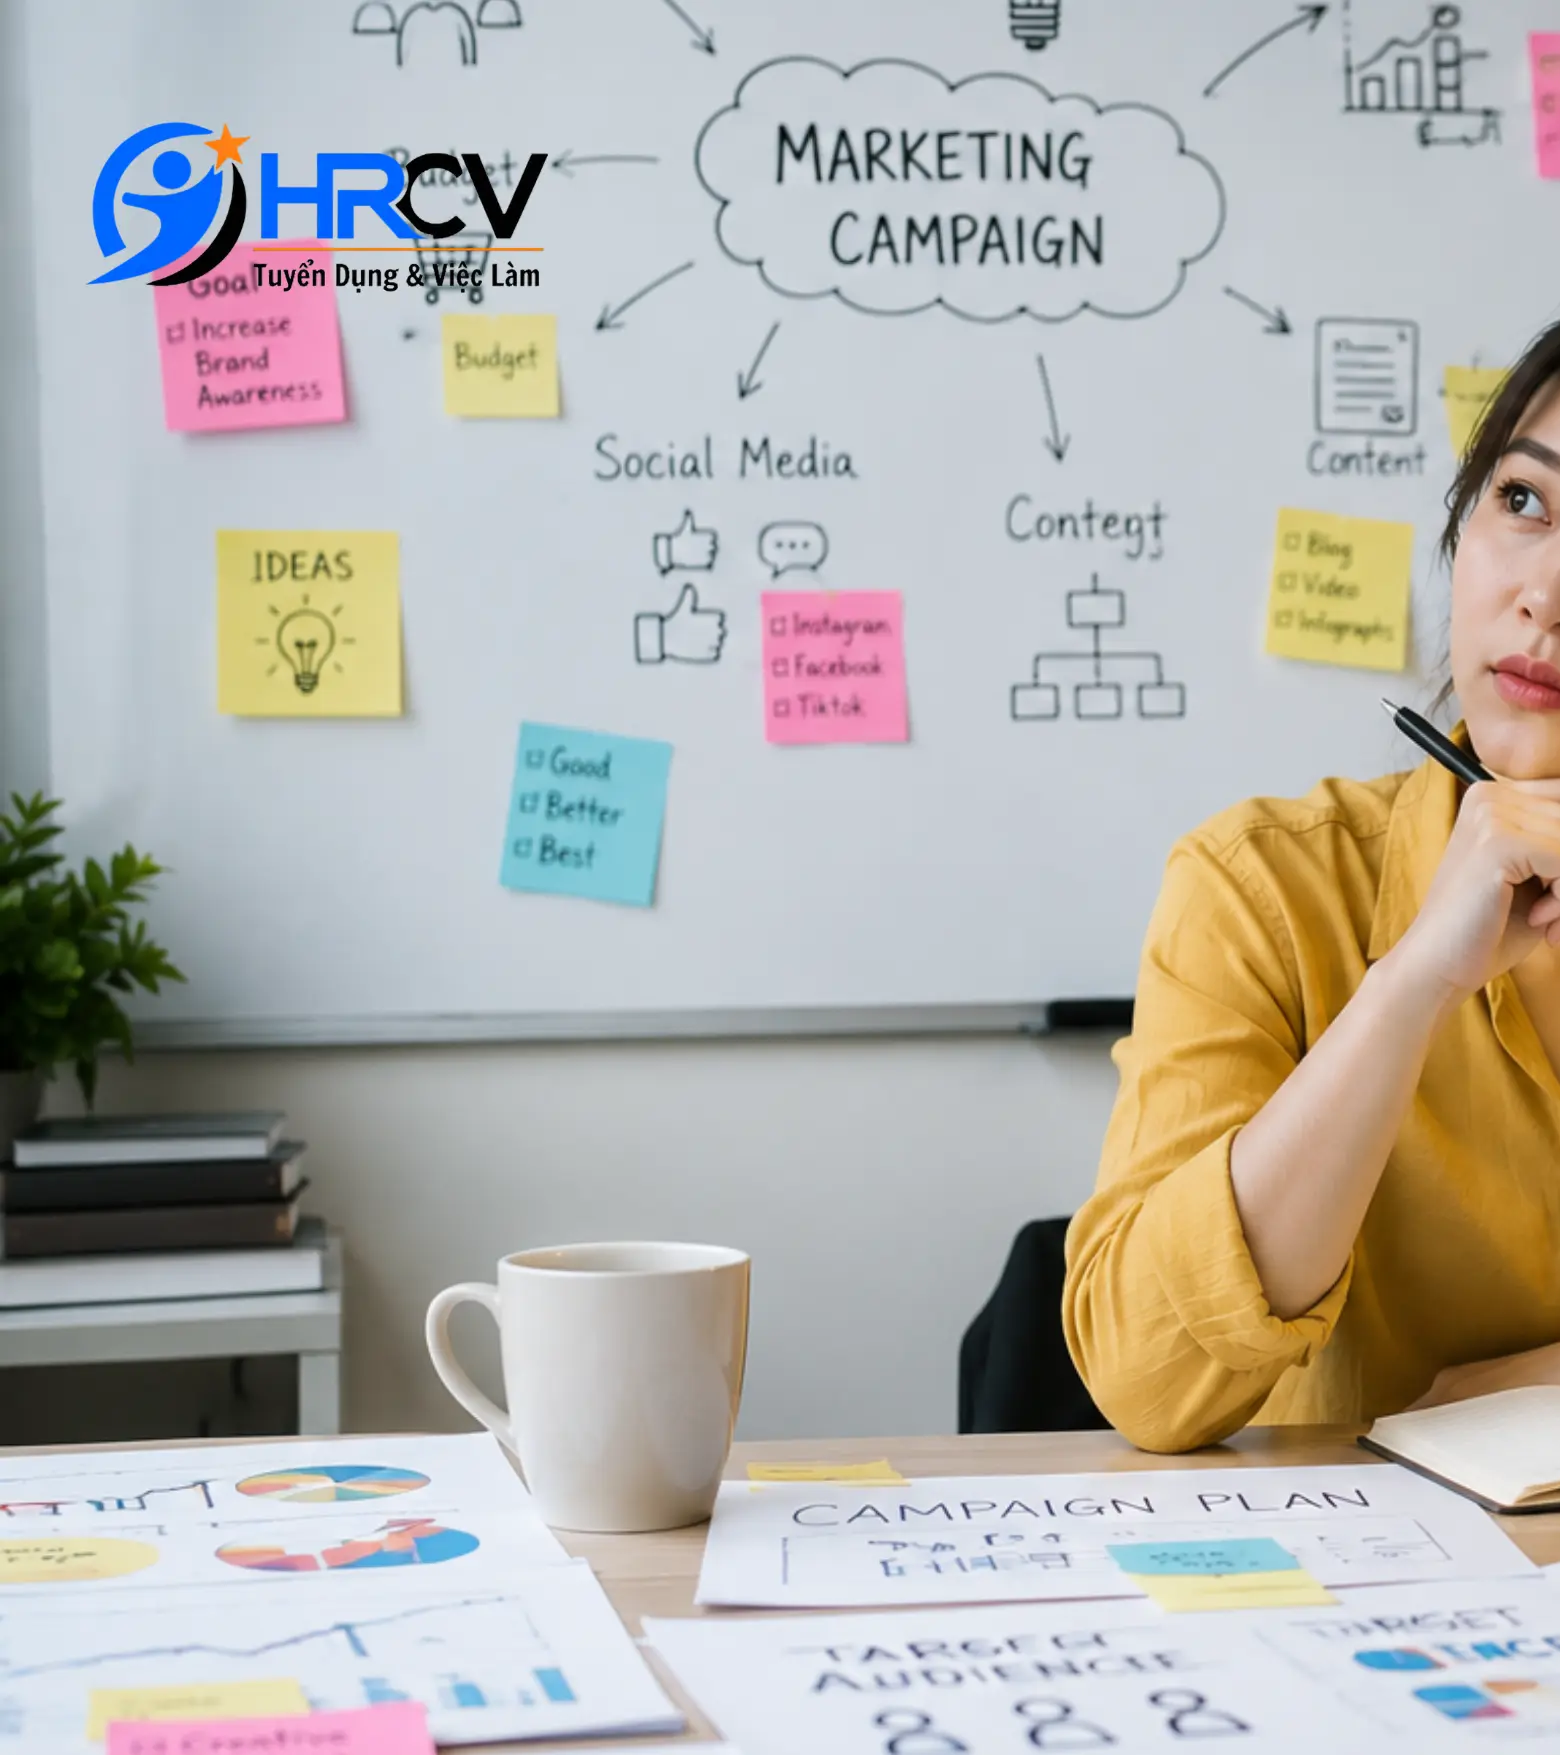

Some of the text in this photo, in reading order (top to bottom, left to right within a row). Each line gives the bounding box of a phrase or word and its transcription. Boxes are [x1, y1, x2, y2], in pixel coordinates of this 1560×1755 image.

[776, 123, 1093, 190] MARKETING
[830, 211, 1104, 268] CAMPAIGN
[192, 317, 291, 342] Increase
[195, 347, 270, 377] Brand
[453, 340, 538, 381] Budget
[198, 379, 323, 410] Awareness
[594, 432, 859, 481] Social Media
[1307, 440, 1427, 478] Content
[252, 549, 355, 583] IDEAS
[1302, 572, 1361, 600] Video
[793, 613, 892, 647] Instagram
[794, 653, 884, 678] Facebook
[549, 744, 613, 781] Good
[545, 788, 625, 828] Better
[538, 832, 597, 871] Best
[791, 1488, 1371, 1528] CAMPAIGN PLAN
